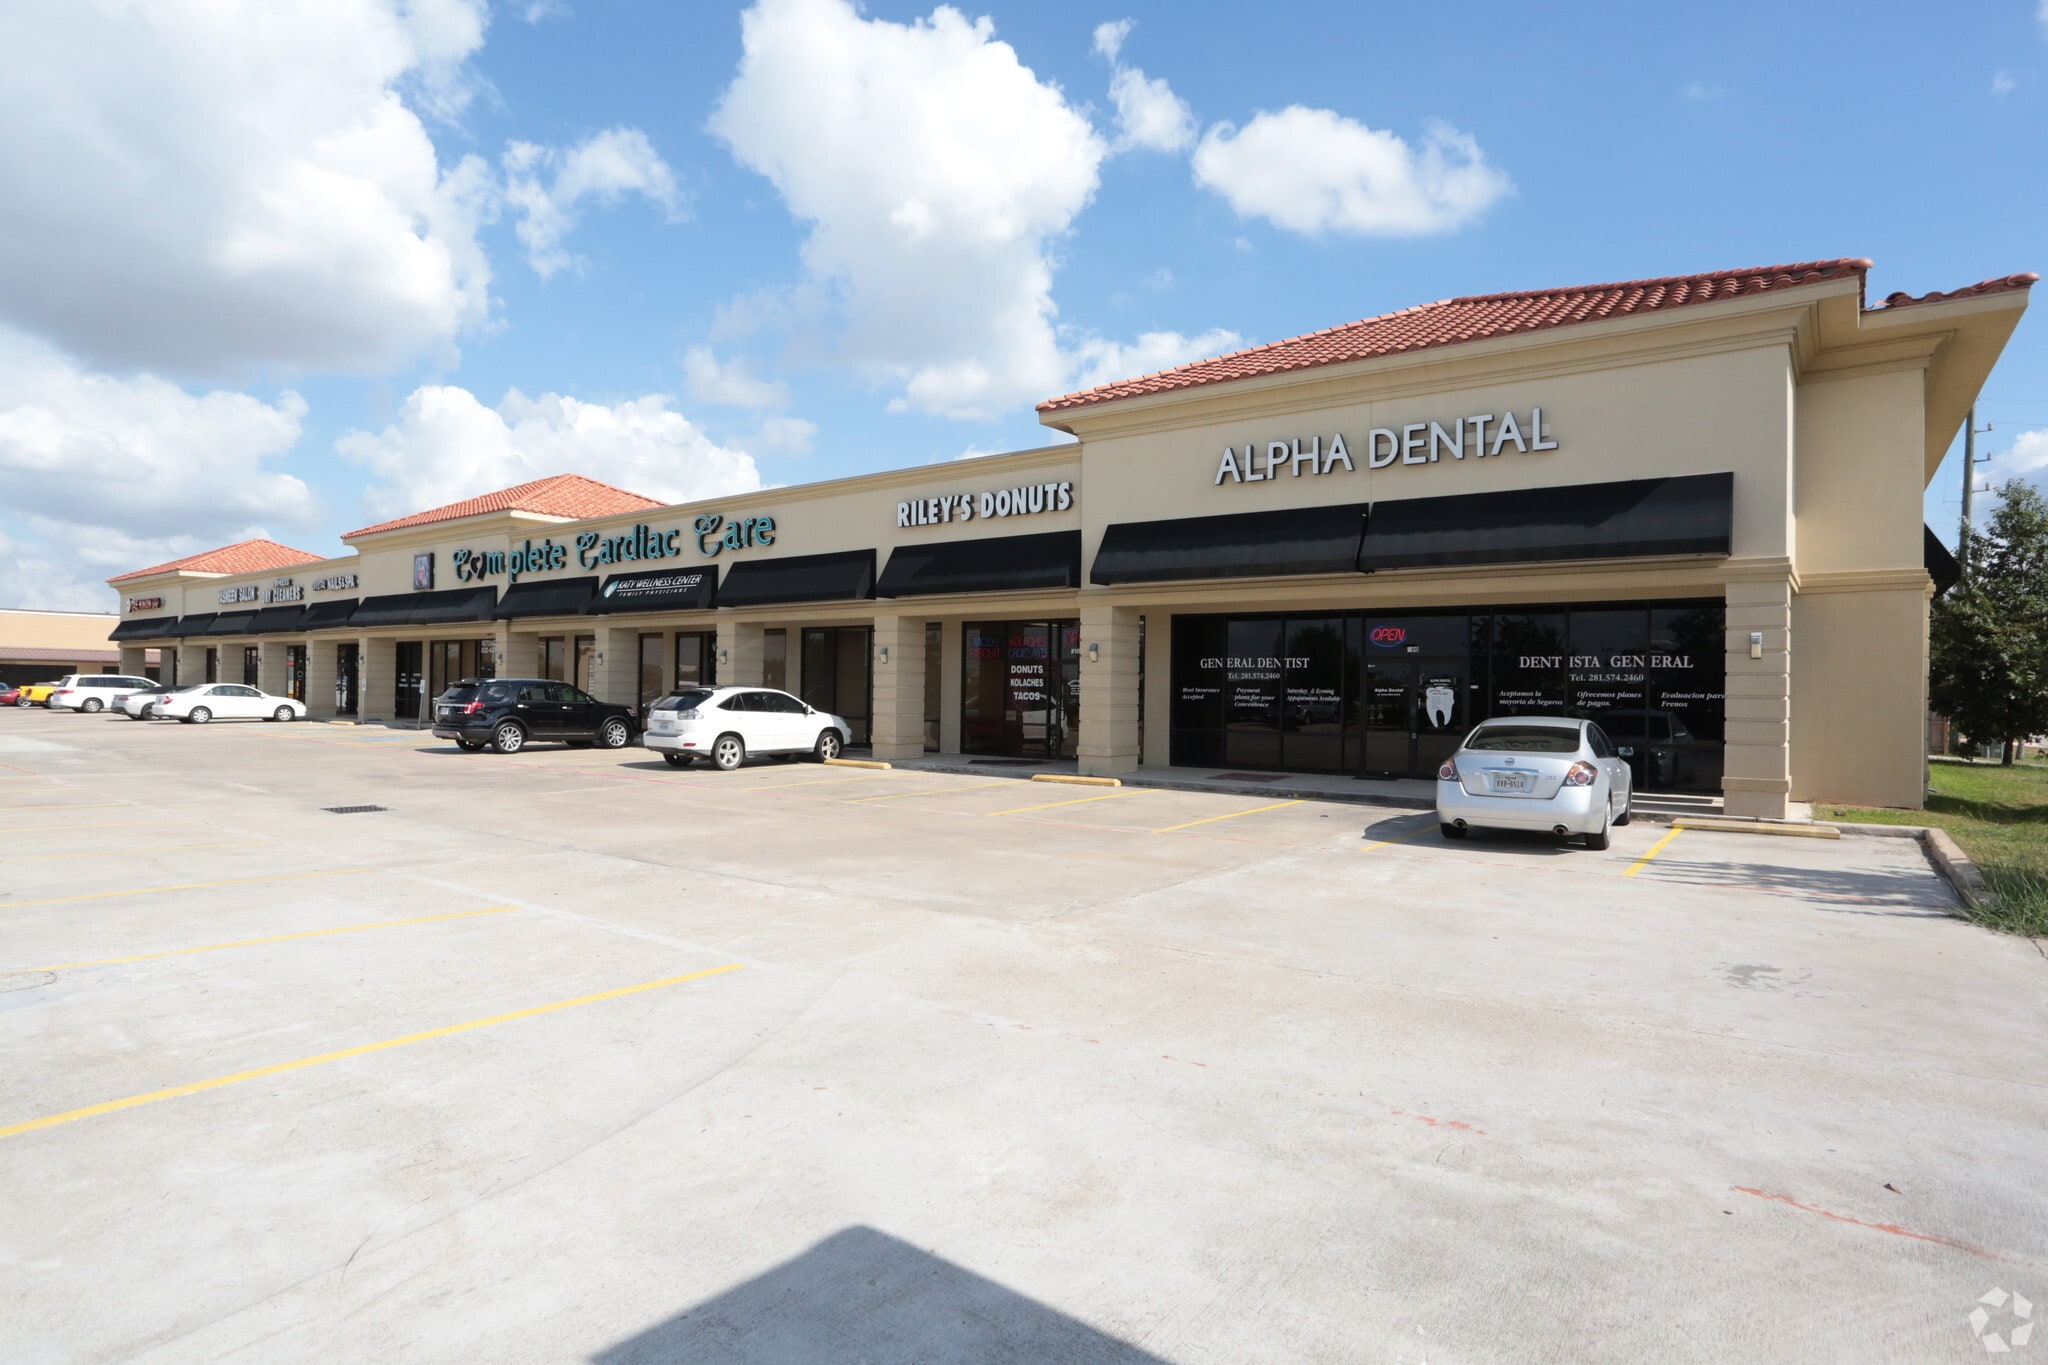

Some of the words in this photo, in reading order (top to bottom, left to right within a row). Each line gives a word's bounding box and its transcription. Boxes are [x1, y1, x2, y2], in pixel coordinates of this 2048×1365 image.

[1215, 433, 1354, 485] ALPHA
[1369, 408, 1558, 469] DENTAL
[898, 494, 973, 527] RILEY'S
[981, 482, 1073, 519] DONUTS
[576, 524, 680, 570] Cardiac
[694, 514, 776, 557] Care
[636, 577, 672, 587] WELLNESS
[673, 574, 702, 584] CENTER
[239, 586, 255, 601] SALON
[272, 587, 301, 602] CLEANERS
[1372, 628, 1406, 641] OPEN
[972, 637, 998, 647] TACOS
[1009, 636, 1047, 647] KOLACHES
[970, 648, 1001, 658] BISCUIT
[1200, 657, 1255, 669] GENERAL
[1257, 657, 1310, 668] DENTIST
[1611, 655, 1693, 668] GENERAL
[1011, 665, 1043, 674] DONUTS
[1227, 672, 1239, 680] Tel.
[1241, 672, 1280, 680] 281.574.2460
[1589, 674, 1644, 682] 281.574.2460
[1010, 679, 1043, 687] KOLACHES
[1287, 687, 1308, 695] Saturday
[1315, 687, 1335, 695] Evening
[1499, 690, 1534, 698] Aceptamos
[1617, 691, 1642, 699] planes
[1661, 691, 1705, 699] Evaluacion
[1014, 692, 1040, 700] TACOS
[1234, 694, 1250, 702] plans
[1250, 694, 1259, 702] for
[1287, 694, 1318, 702] Appointments
[1499, 698, 1526, 706] mayoria
[1537, 698, 1563, 706] Seguros
